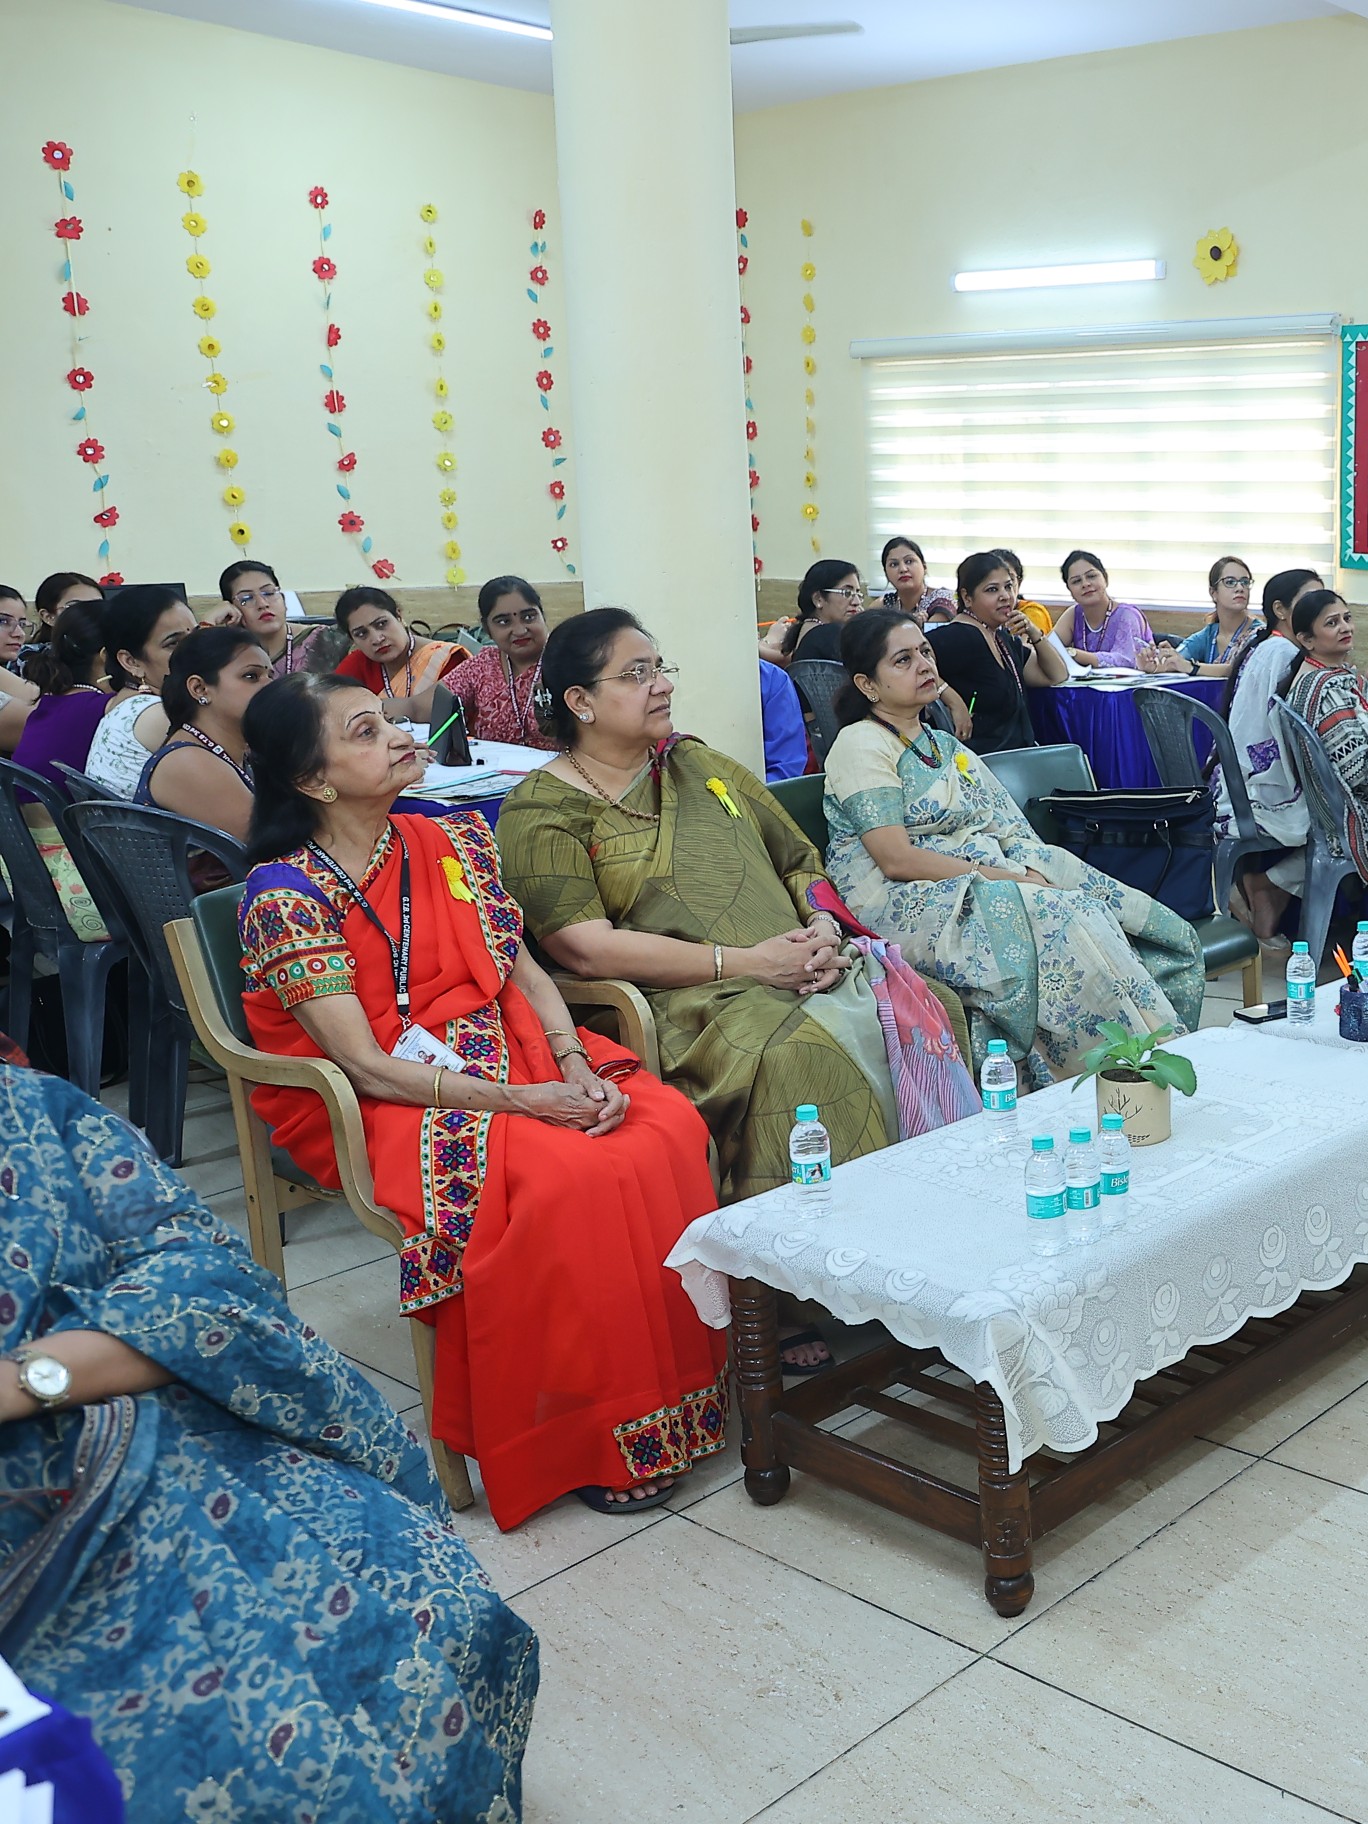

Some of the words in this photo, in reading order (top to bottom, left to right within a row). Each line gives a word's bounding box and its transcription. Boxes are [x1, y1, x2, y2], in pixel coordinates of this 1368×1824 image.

[313, 848, 347, 880] CENTENARY
[343, 878, 356, 890] 3rd
[402, 914, 410, 924] 3rd
[400, 924, 411, 966] CENTENARY
[398, 966, 408, 993] PUBLIC
